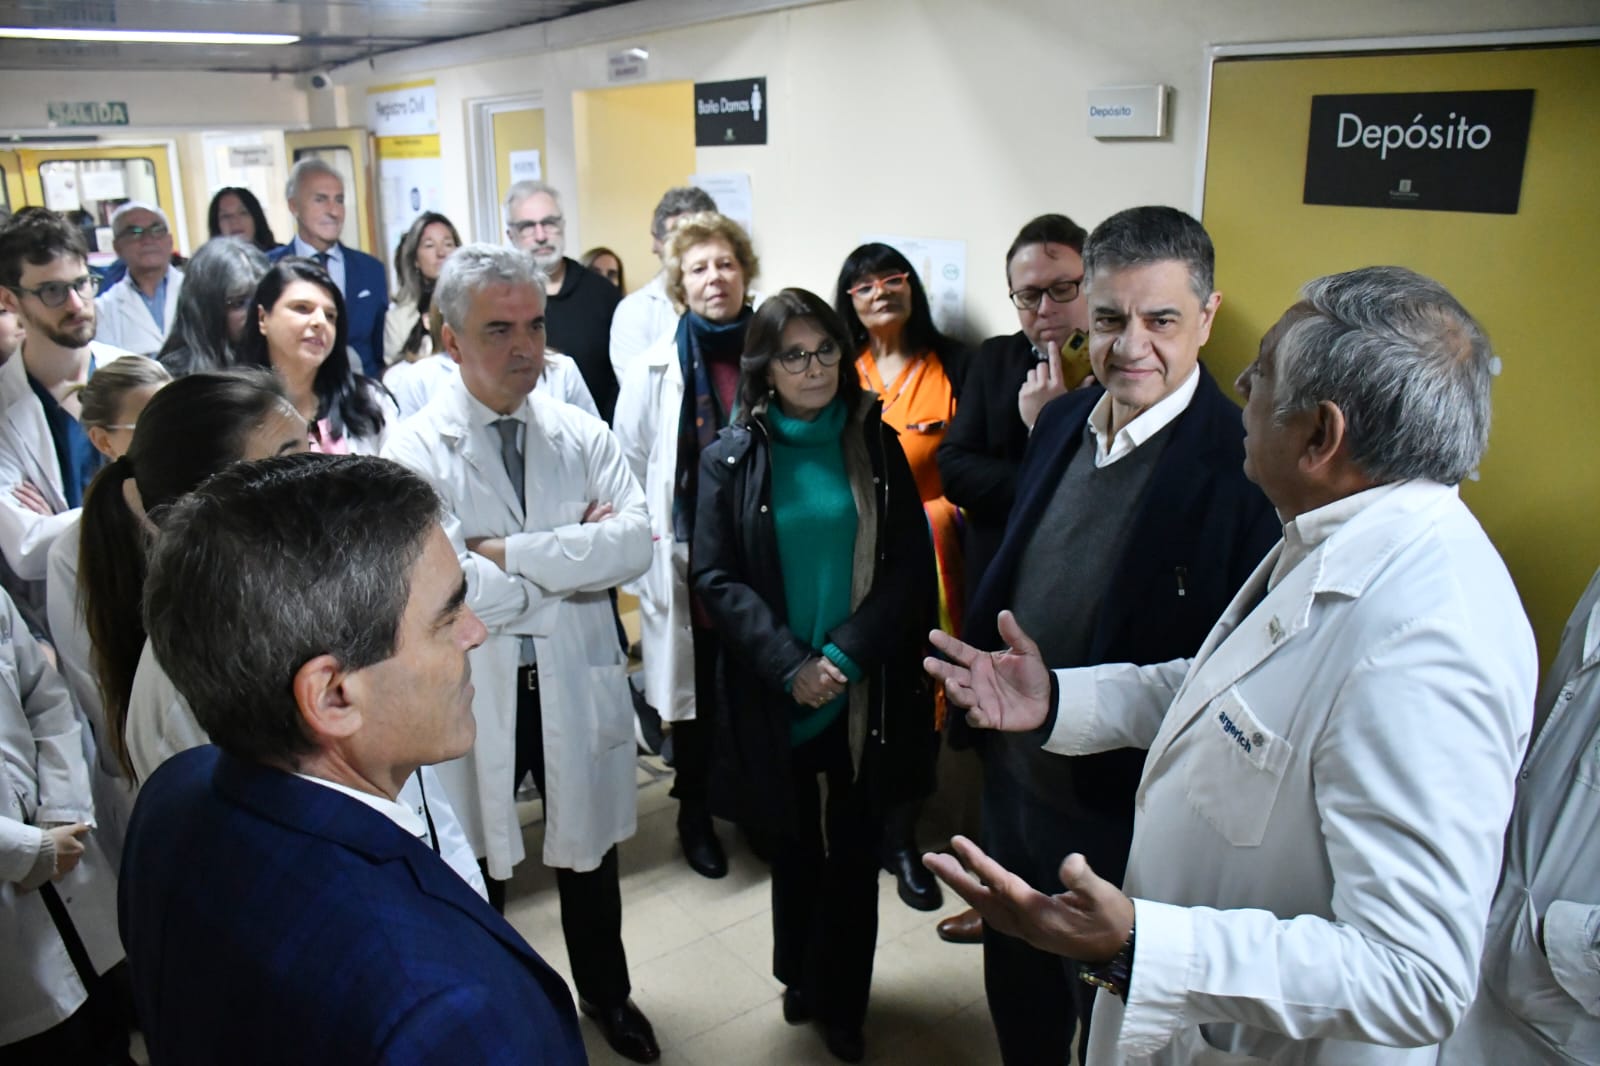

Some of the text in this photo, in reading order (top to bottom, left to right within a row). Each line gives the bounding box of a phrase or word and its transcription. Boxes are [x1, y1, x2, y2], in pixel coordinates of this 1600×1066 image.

[53, 104, 126, 124] SALIDA
[698, 97, 750, 115] Baño Damas
[1089, 106, 1131, 117] Depósito
[1336, 112, 1492, 160] Depósito
[1219, 711, 1252, 753] argerich
